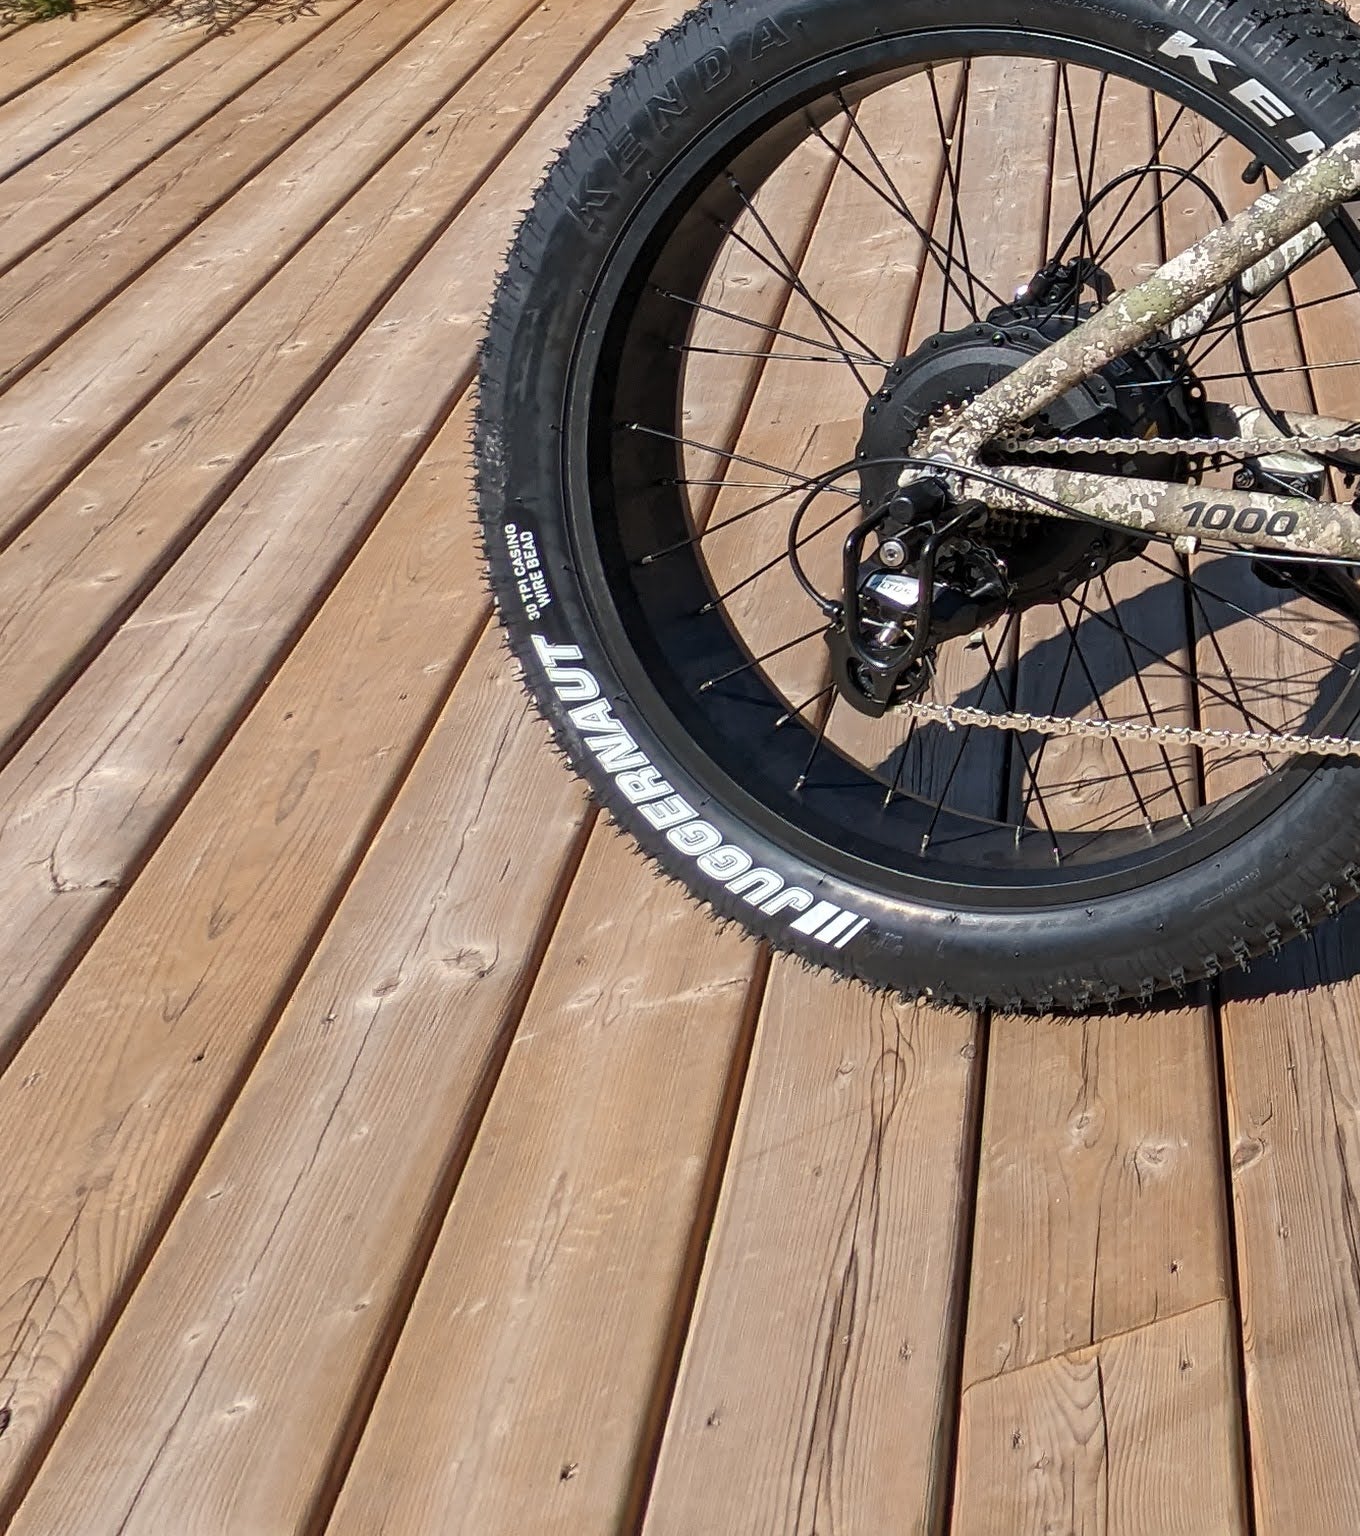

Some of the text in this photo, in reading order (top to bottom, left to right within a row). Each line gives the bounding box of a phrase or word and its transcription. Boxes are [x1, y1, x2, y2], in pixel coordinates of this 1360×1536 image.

[565, 13, 791, 232] KENDA
[1180, 500, 1299, 538] 1000
[504, 523, 541, 622] 30 TPI CASING
[520, 531, 552, 608] WIRE BEAD
[530, 633, 814, 918] JUGGERNAUT
